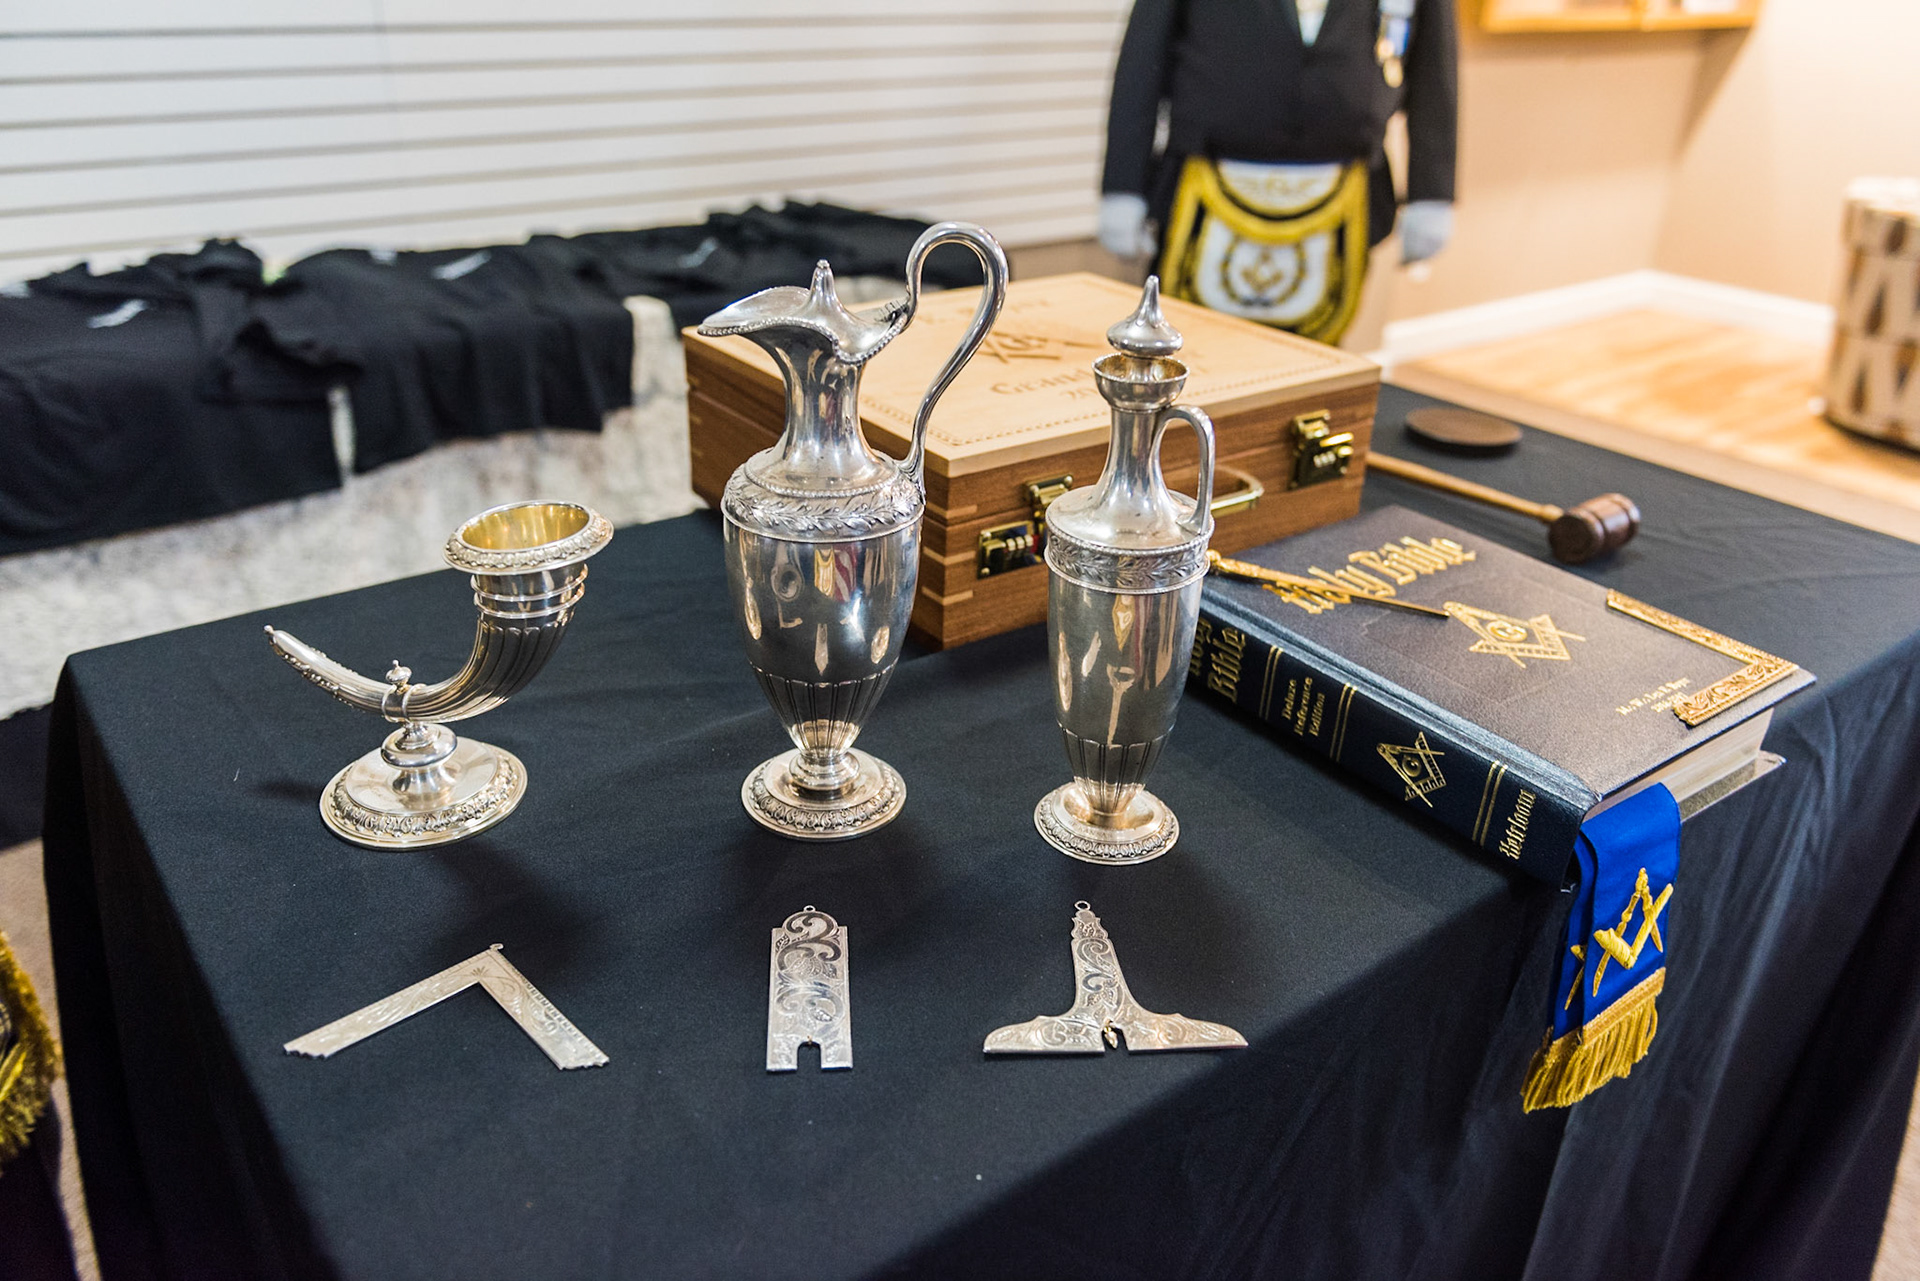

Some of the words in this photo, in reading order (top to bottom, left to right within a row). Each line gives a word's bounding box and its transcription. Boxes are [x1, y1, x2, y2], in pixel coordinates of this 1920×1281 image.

[1348, 535, 1477, 586] Bible
[1206, 627, 1246, 705] Bible
[1499, 788, 1537, 860] Heirloom
